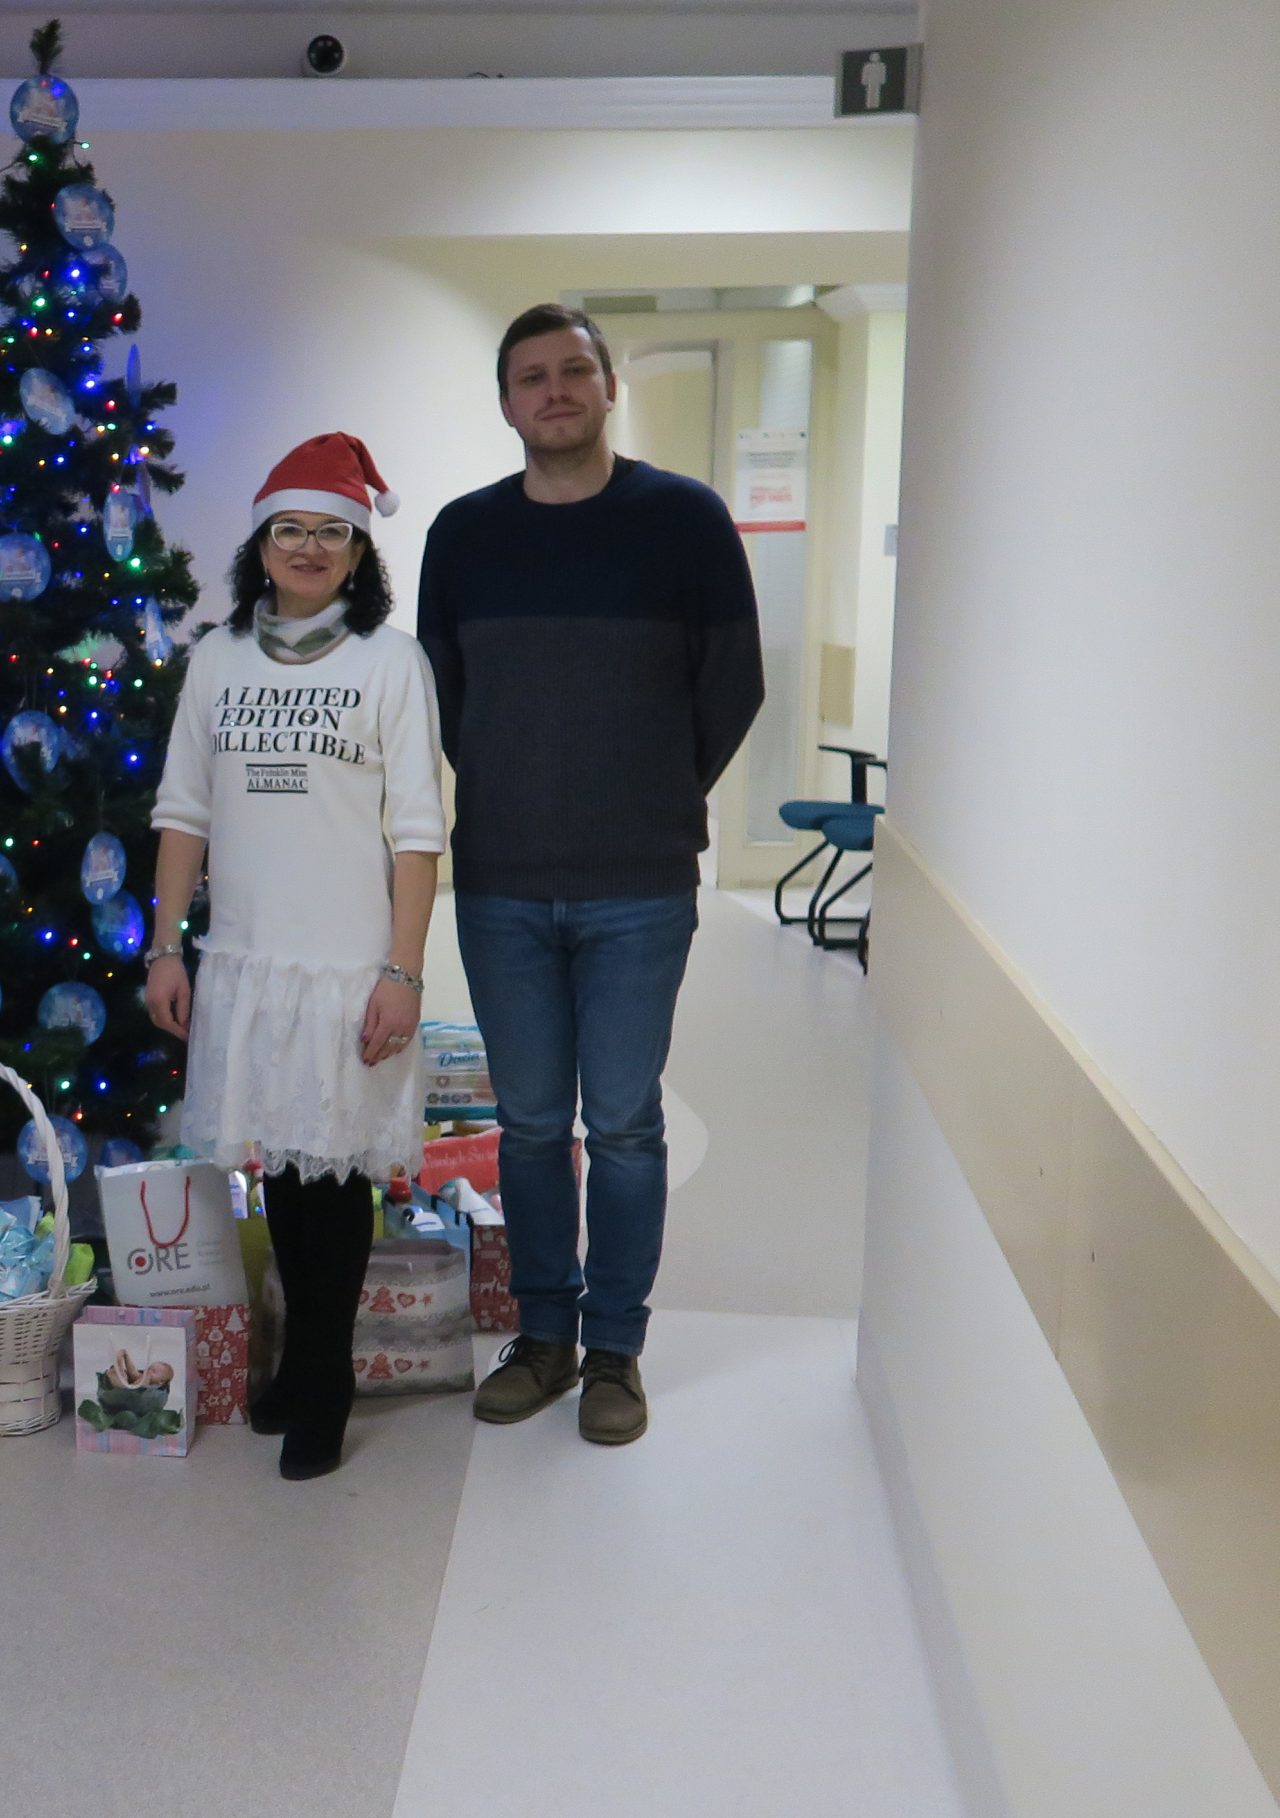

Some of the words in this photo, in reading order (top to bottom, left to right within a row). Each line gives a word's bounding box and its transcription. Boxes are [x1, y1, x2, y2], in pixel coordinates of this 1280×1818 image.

[215, 687, 231, 707] A
[238, 687, 362, 709] LIMITED
[219, 708, 342, 732] EDITION
[212, 731, 366, 765] LLECTIBLE
[248, 778, 309, 789] ALMANAC
[127, 1242, 191, 1276] ORE
